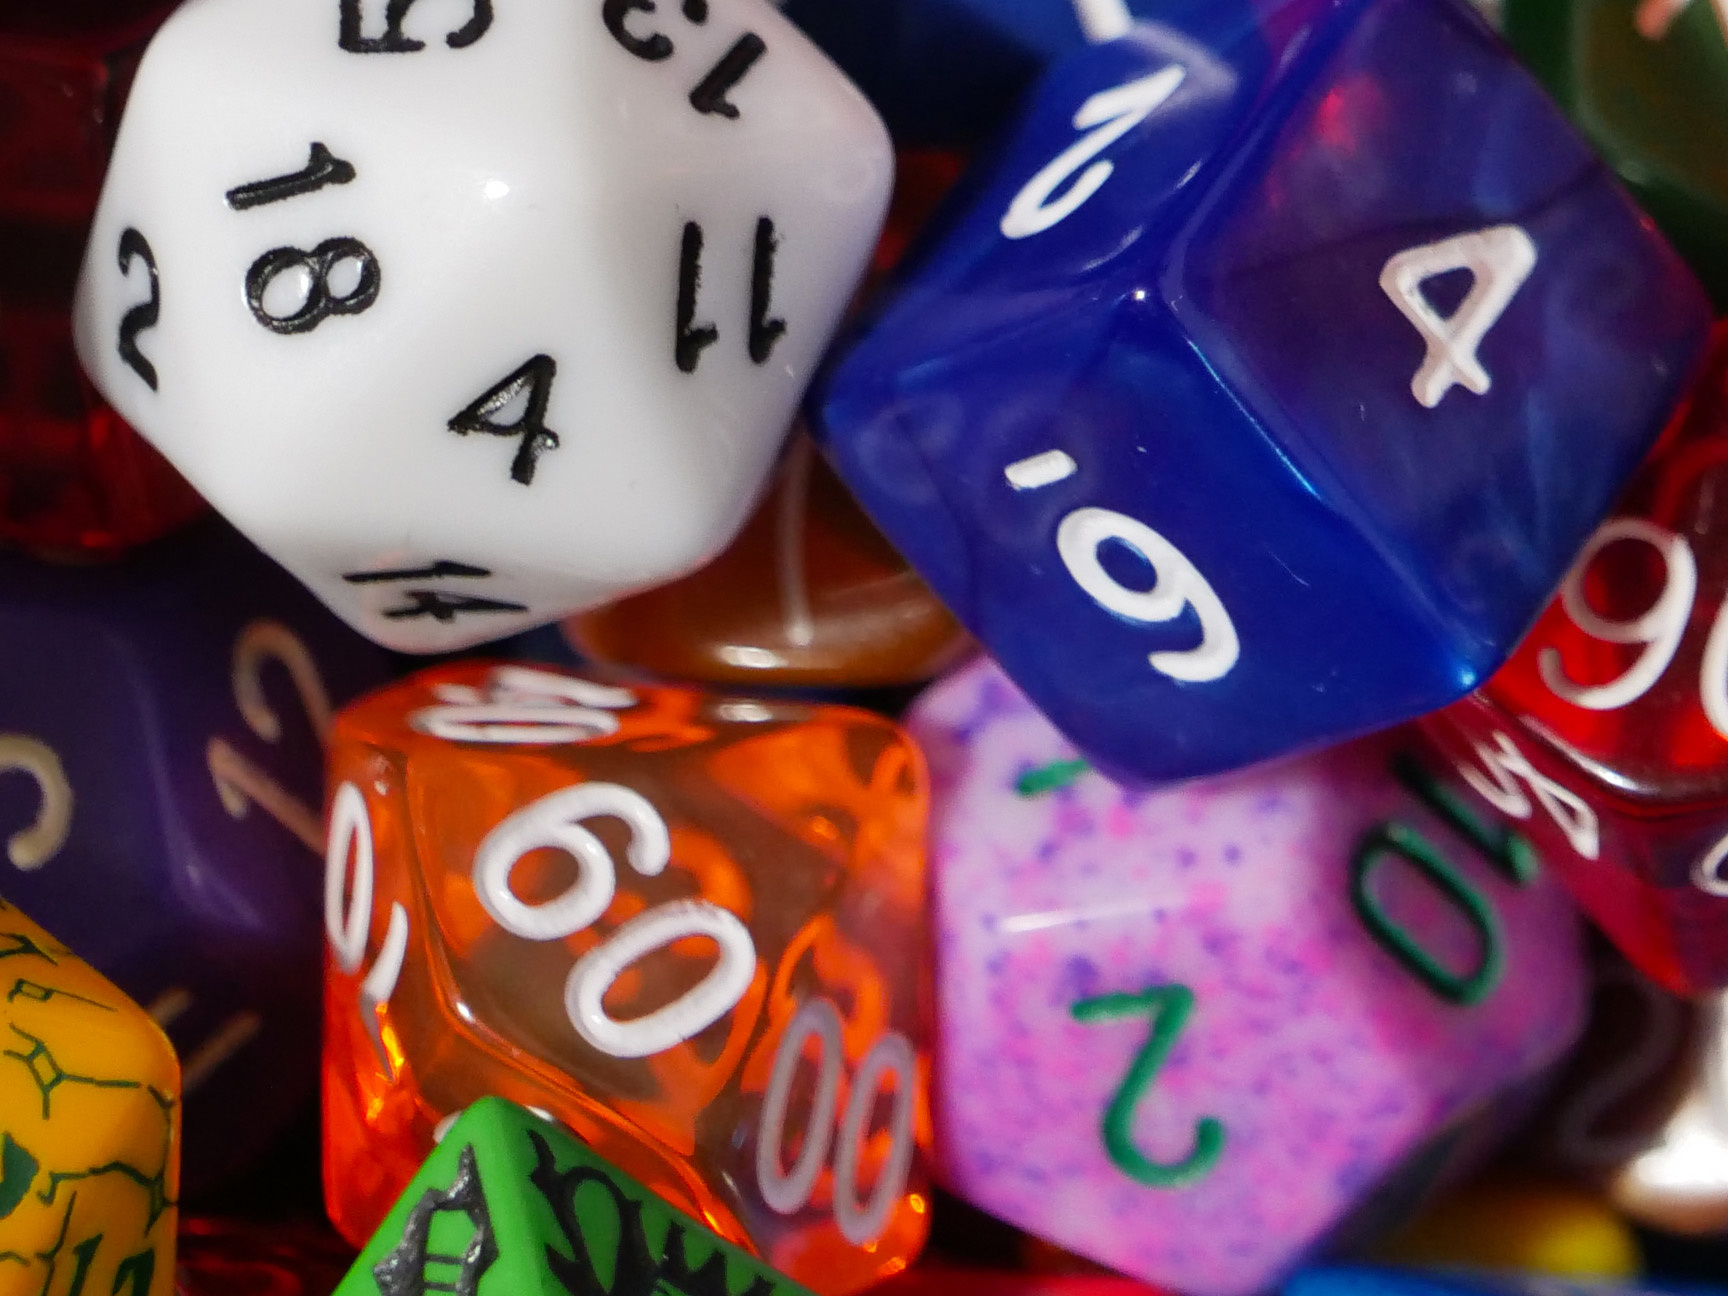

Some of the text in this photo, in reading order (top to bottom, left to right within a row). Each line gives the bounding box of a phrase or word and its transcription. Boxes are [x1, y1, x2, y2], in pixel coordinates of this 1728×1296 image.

[222, 140, 383, 336] 18
[998, 64, 1188, 242] 2
[115, 226, 163, 394] 2
[673, 216, 790, 376] 11
[1376, 223, 1541, 411] 4
[447, 352, 562, 488] 4
[341, 556, 531, 626] 14
[470, 779, 760, 1060] 60
[755, 994, 918, 1248] 00
[1070, 980, 1228, 1192] 2
